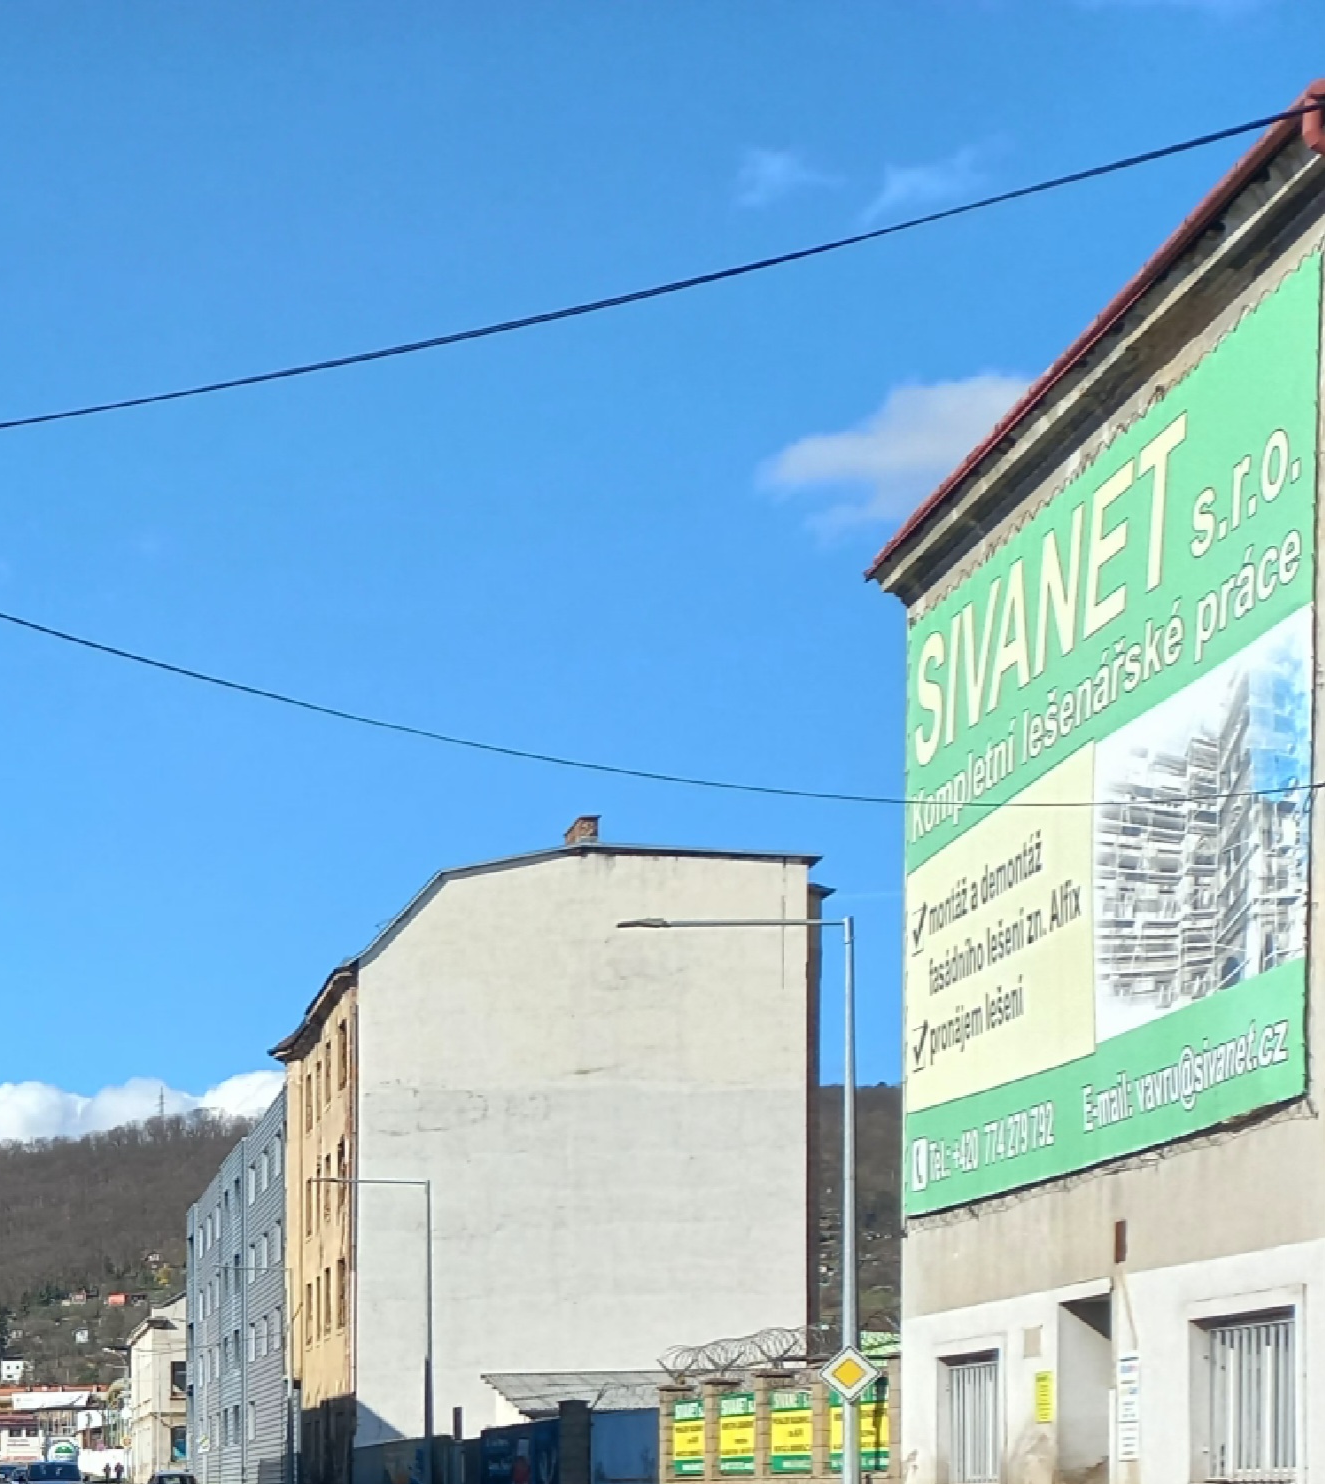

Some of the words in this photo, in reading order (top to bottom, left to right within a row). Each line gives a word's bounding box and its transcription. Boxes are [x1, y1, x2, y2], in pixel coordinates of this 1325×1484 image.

[915, 411, 1188, 767] SIVANET
[1190, 429, 1301, 558] s.r.o.
[910, 717, 1016, 843] Kompletní
[1021, 597, 1185, 764] lešenářské
[1195, 529, 1302, 663] práce
[928, 877, 969, 936] montáž
[970, 881, 979, 912] a
[981, 829, 1043, 905] demontáž
[986, 906, 1025, 967] lešení
[1049, 879, 1082, 933] Alfix
[930, 1005, 984, 1066] pronájem
[985, 973, 1025, 1032] lešení
[984, 1119, 1005, 1166] 774
[1030, 1100, 1055, 1152] 792
[1082, 1070, 1133, 1133] E-mail:
